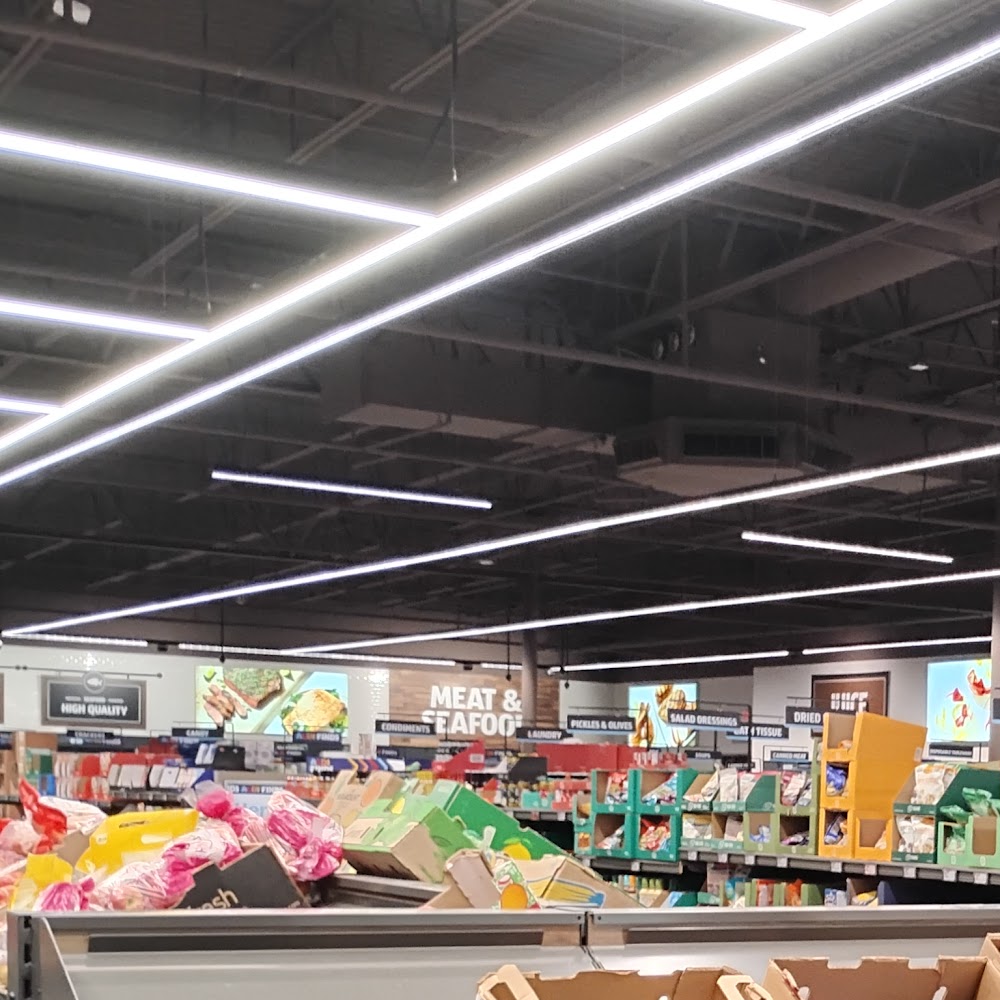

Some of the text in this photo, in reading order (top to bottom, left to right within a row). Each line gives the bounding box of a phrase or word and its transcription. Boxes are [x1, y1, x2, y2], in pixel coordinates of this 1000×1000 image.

[430, 685, 522, 712] MEAT &
[61, 703, 128, 718] HIGH QUALITY
[670, 713, 738, 727] SALAD DRESSINGS
[793, 711, 821, 724] DRIED
[381, 722, 431, 734] CONDIMENTS
[571, 719, 599, 729] PICKLES
[607, 720, 633, 730] OLIVES
[527, 730, 561, 739] LAUNDRY
[756, 726, 782, 737] TISSUE
